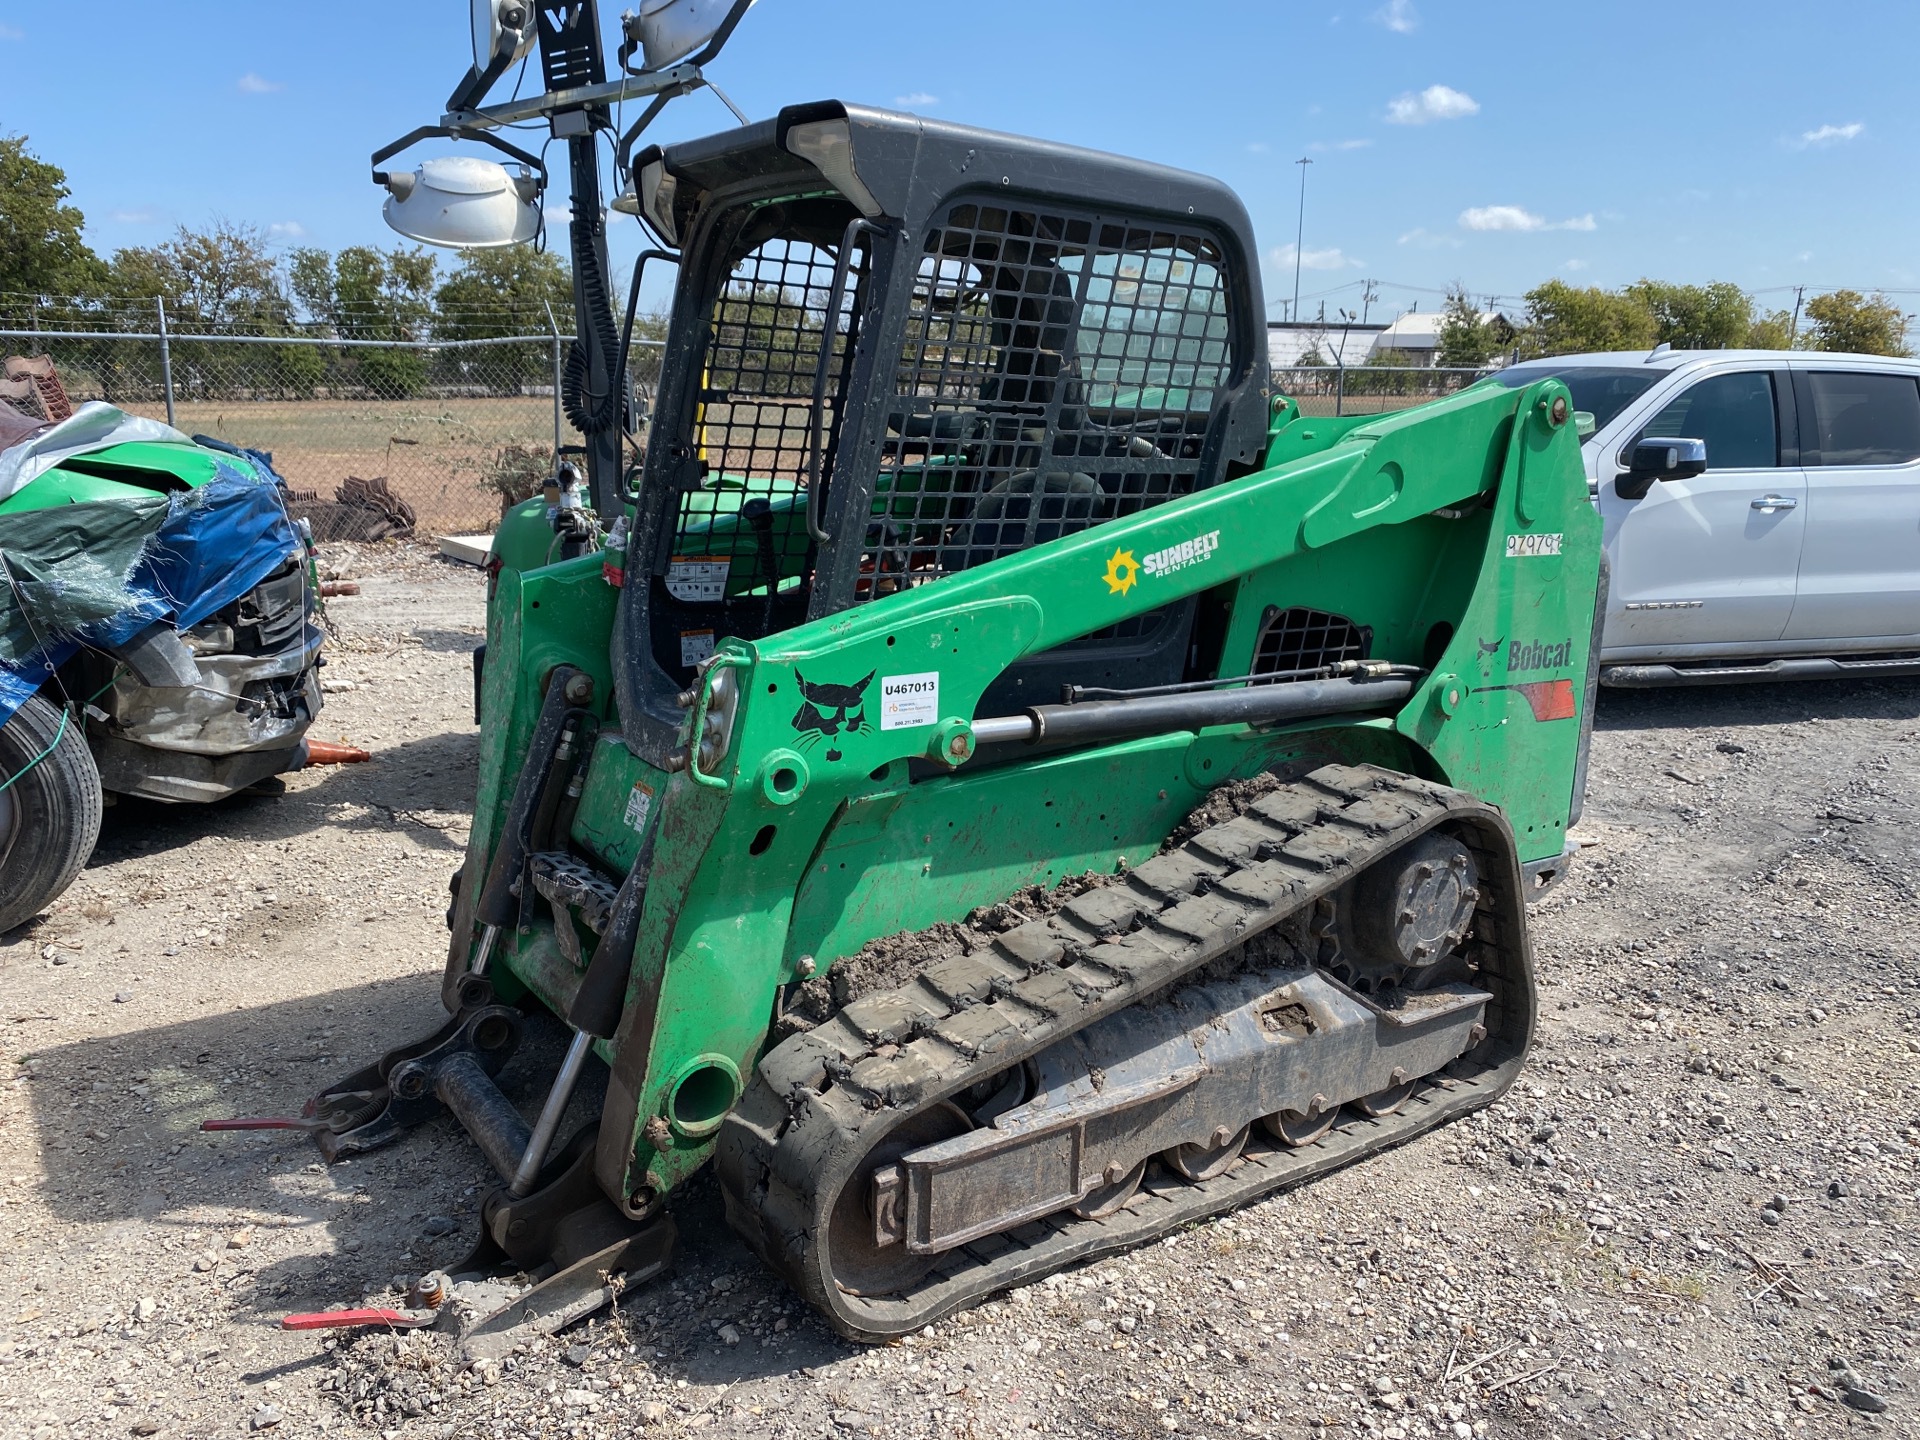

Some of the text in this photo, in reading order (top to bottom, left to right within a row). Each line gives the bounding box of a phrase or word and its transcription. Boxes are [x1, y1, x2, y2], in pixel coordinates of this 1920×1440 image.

[1142, 529, 1220, 575] SUNBELT
[1155, 551, 1211, 578] RENTALS
[1507, 638, 1572, 672] Bobcat
[885, 681, 935, 695] U467013
